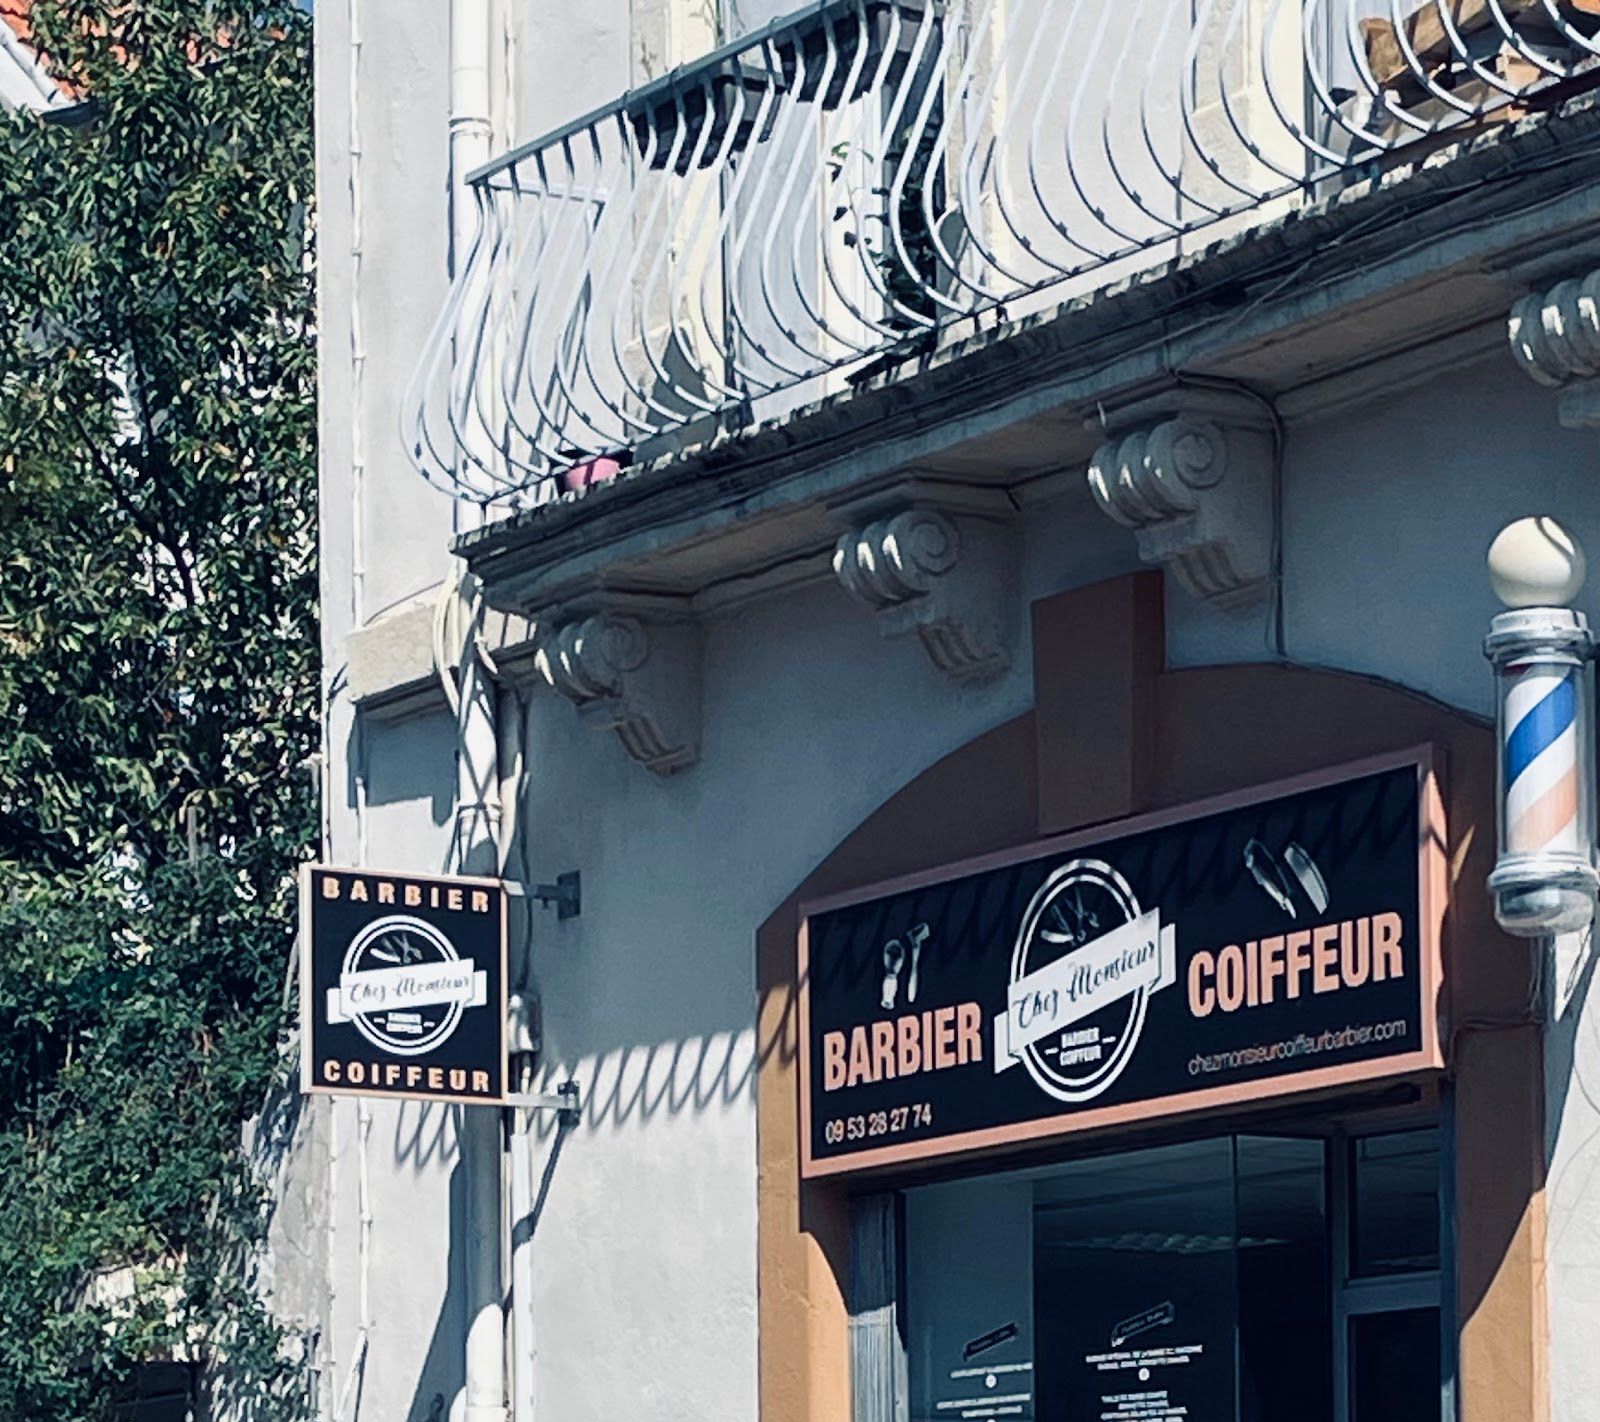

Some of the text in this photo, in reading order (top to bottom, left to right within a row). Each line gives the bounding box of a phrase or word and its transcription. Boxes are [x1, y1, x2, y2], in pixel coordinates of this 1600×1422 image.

[321, 876, 489, 913] BARBIER
[1013, 941, 1155, 1028] Chez Monsieur
[1188, 911, 1404, 1018] COIFFEUR
[346, 975, 470, 1004] Chez Monsieur
[823, 1001, 983, 1092] BARBIER
[1188, 1019, 1407, 1076] chezmonsieurcoiffeurbarbier.com
[323, 1059, 490, 1093] COIFFEUR
[825, 1102, 932, 1144] 09 53 28 27 74
